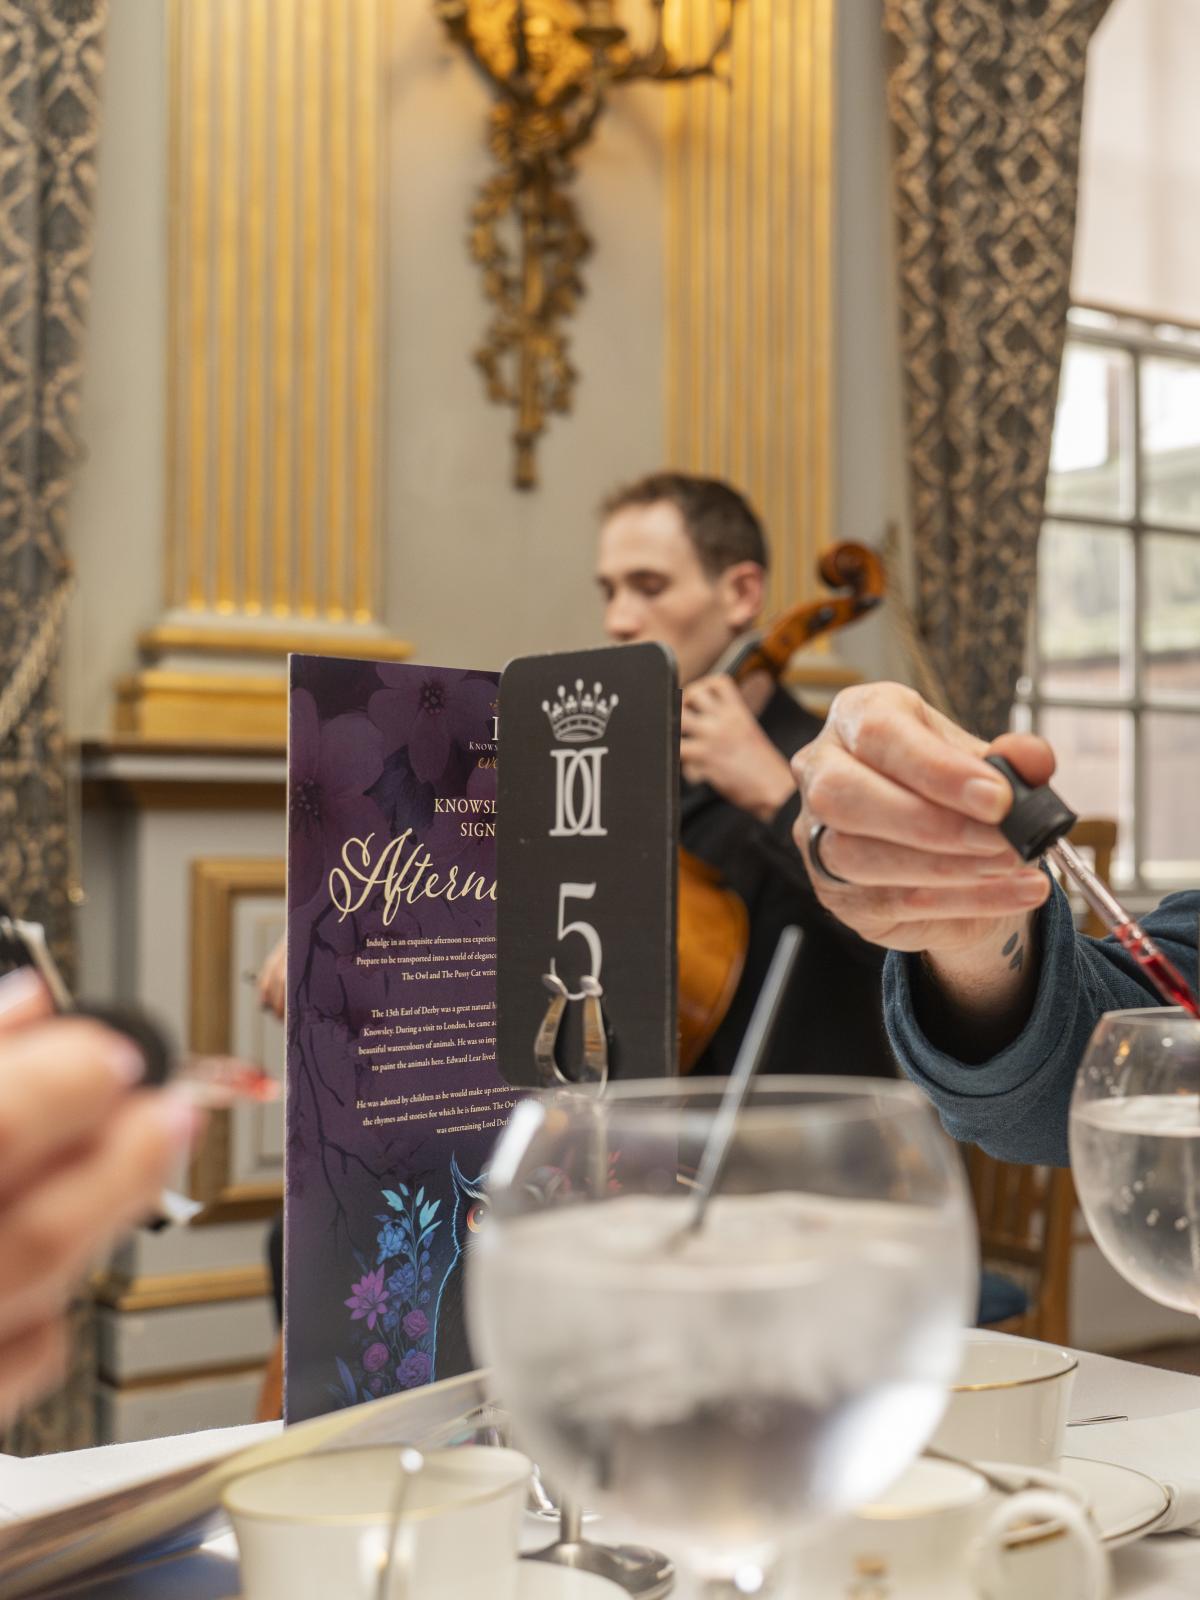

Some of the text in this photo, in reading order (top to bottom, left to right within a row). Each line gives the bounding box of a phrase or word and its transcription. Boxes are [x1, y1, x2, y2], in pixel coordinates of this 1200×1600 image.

[460, 823, 496, 837] SIGN
[367, 939, 389, 948] Indulge
[407, 937, 432, 947] exquisite
[434, 936, 461, 944] afternoon
[549, 882, 603, 1000] 5
[357, 957, 379, 967] Prepare
[397, 954, 431, 965] transported
[416, 972, 428, 980] Owl
[442, 970, 453, 978] The
[371, 1010, 384, 1018] The
[386, 1008, 399, 1017] 13th
[401, 1008, 413, 1016] Earl
[422, 1006, 440, 1015] Derby
[457, 1005, 470, 1013] great
[472, 1003, 491, 1011] natural
[396, 1026, 417, 1034] During
[358, 1044, 386, 1055] beautiful
[387, 1044, 424, 1052] watercolours
[380, 1064, 395, 1073] paint
[397, 1061, 406, 1069] the
[408, 1058, 430, 1068] animals
[447, 1054, 467, 1064] Edward
[482, 1052, 495, 1060] lived
[380, 1096, 400, 1106] adored
[410, 1094, 434, 1103] children
[450, 1089, 467, 1098] would
[469, 1088, 483, 1096] make
[363, 1118, 373, 1126] the
[374, 1116, 396, 1126] rhymes
[397, 1114, 408, 1122] and
[409, 1111, 427, 1120] stories
[429, 1110, 437, 1118] for
[439, 1108, 456, 1117] which
[493, 1102, 503, 1110] The
[448, 1123, 481, 1133] entertaining
[482, 1120, 495, 1128] Lord
